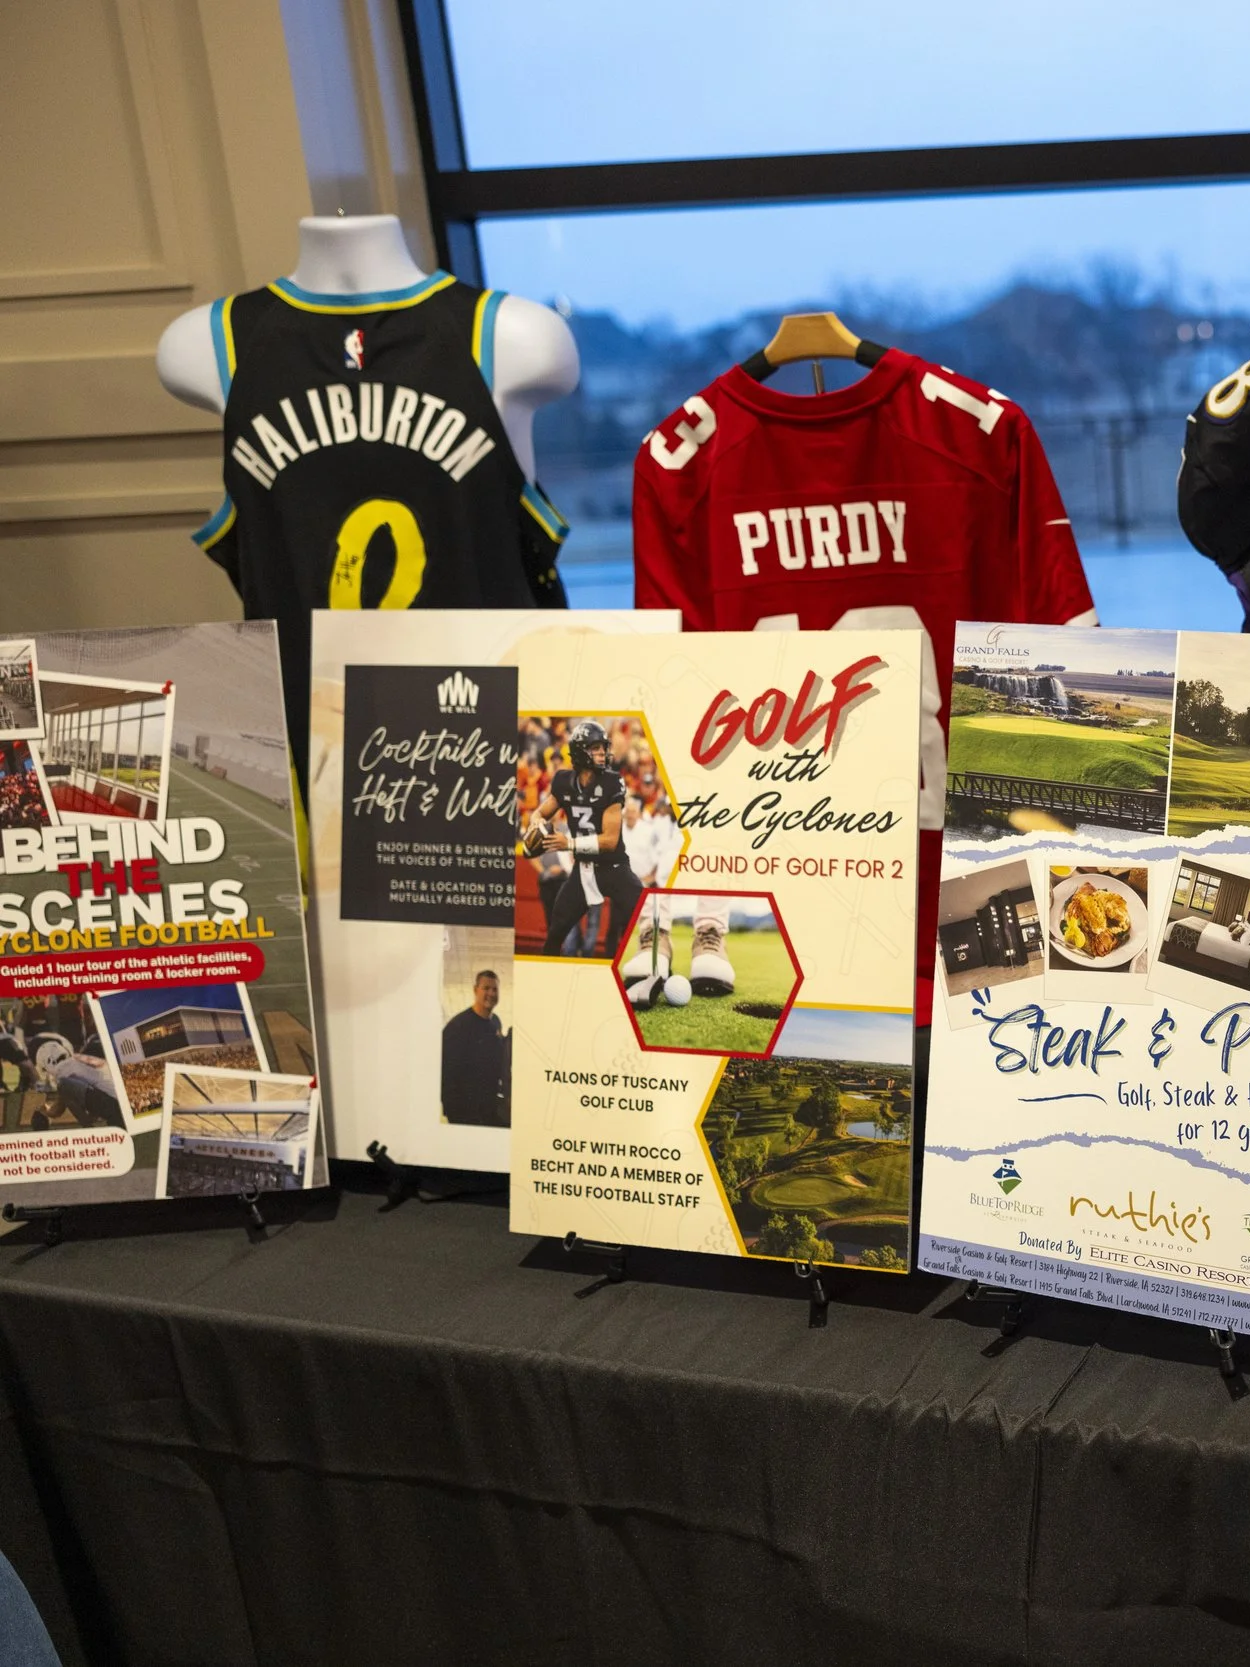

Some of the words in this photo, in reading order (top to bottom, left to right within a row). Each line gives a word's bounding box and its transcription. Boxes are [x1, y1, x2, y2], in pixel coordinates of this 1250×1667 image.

[231, 382, 496, 490] HALIBURTON
[733, 502, 907, 576] PURDY
[956, 646, 995, 655] GRAND
[998, 648, 1030, 656] FALLS
[440, 706, 454, 714] WE
[455, 706, 477, 714] WILL
[691, 655, 888, 768] GOLF
[358, 726, 494, 775] Cocktails
[748, 747, 830, 782] with
[420, 783, 439, 816] &
[573, 807, 591, 836] 3
[676, 793, 739, 829] the
[741, 791, 901, 849] Cyclones
[2, 816, 225, 875] BEHIND
[377, 841, 410, 852] ENJOY
[412, 843, 452, 854] DINNER
[465, 844, 504, 856] DRINKS
[376, 854, 396, 865] THE
[399, 855, 436, 866] VOICES
[678, 853, 748, 874] ROUND
[754, 856, 780, 875] OF
[786, 857, 839, 877] GOLF
[845, 859, 884, 879] FOR
[891, 860, 903, 879] 2
[58, 858, 161, 898] THE
[390, 879, 417, 891] DATE
[430, 881, 485, 893] LOCATION
[0, 879, 249, 937] SCENES
[389, 892, 443, 904] MUTUALLY
[445, 894, 487, 906] AGREED
[120, 917, 275, 946] FOOTBALL
[0, 964, 43, 976] Guided
[56, 962, 84, 973] hour
[86, 960, 111, 971] tour
[150, 954, 195, 967] athletic
[197, 951, 252, 964] facilities,
[14, 976, 70, 988] including
[72, 972, 119, 984] training
[121, 971, 152, 981] room
[166, 967, 204, 978] locker
[206, 966, 240, 976] room.
[972, 1004, 1127, 1075] Steak
[1147, 1007, 1176, 1068] &
[545, 1070, 597, 1085] TALONS
[601, 1074, 619, 1087] OF
[622, 1075, 689, 1092] TUSCANY
[580, 1095, 615, 1109] GOLF
[618, 1098, 653, 1112] CLUB
[1118, 1081, 1156, 1111] Golf,
[1163, 1081, 1215, 1107] Steak
[72, 1133, 125, 1145] mutually
[1177, 1123, 1204, 1145] for
[1212, 1120, 1230, 1140] 12
[29, 1149, 75, 1161] football
[79, 1147, 109, 1158] staff.
[552, 1138, 587, 1152] GOLF
[590, 1142, 626, 1156] WITH
[629, 1145, 681, 1161] ROCCO
[44, 1160, 115, 1173] considered.
[531, 1159, 574, 1174] BECHT
[577, 1163, 607, 1177] AND
[623, 1167, 681, 1184] MEMBER
[561, 1184, 582, 1197] ISU
[586, 1186, 654, 1204] FOOTBALL
[658, 1193, 700, 1208] STAFF
[1069, 1190, 1211, 1243] ruthie's
[1019, 1231, 1063, 1252] Donated
[1066, 1240, 1082, 1261] By
[1090, 1247, 1128, 1263] ELITE
[1133, 1255, 1191, 1275] CASINO
